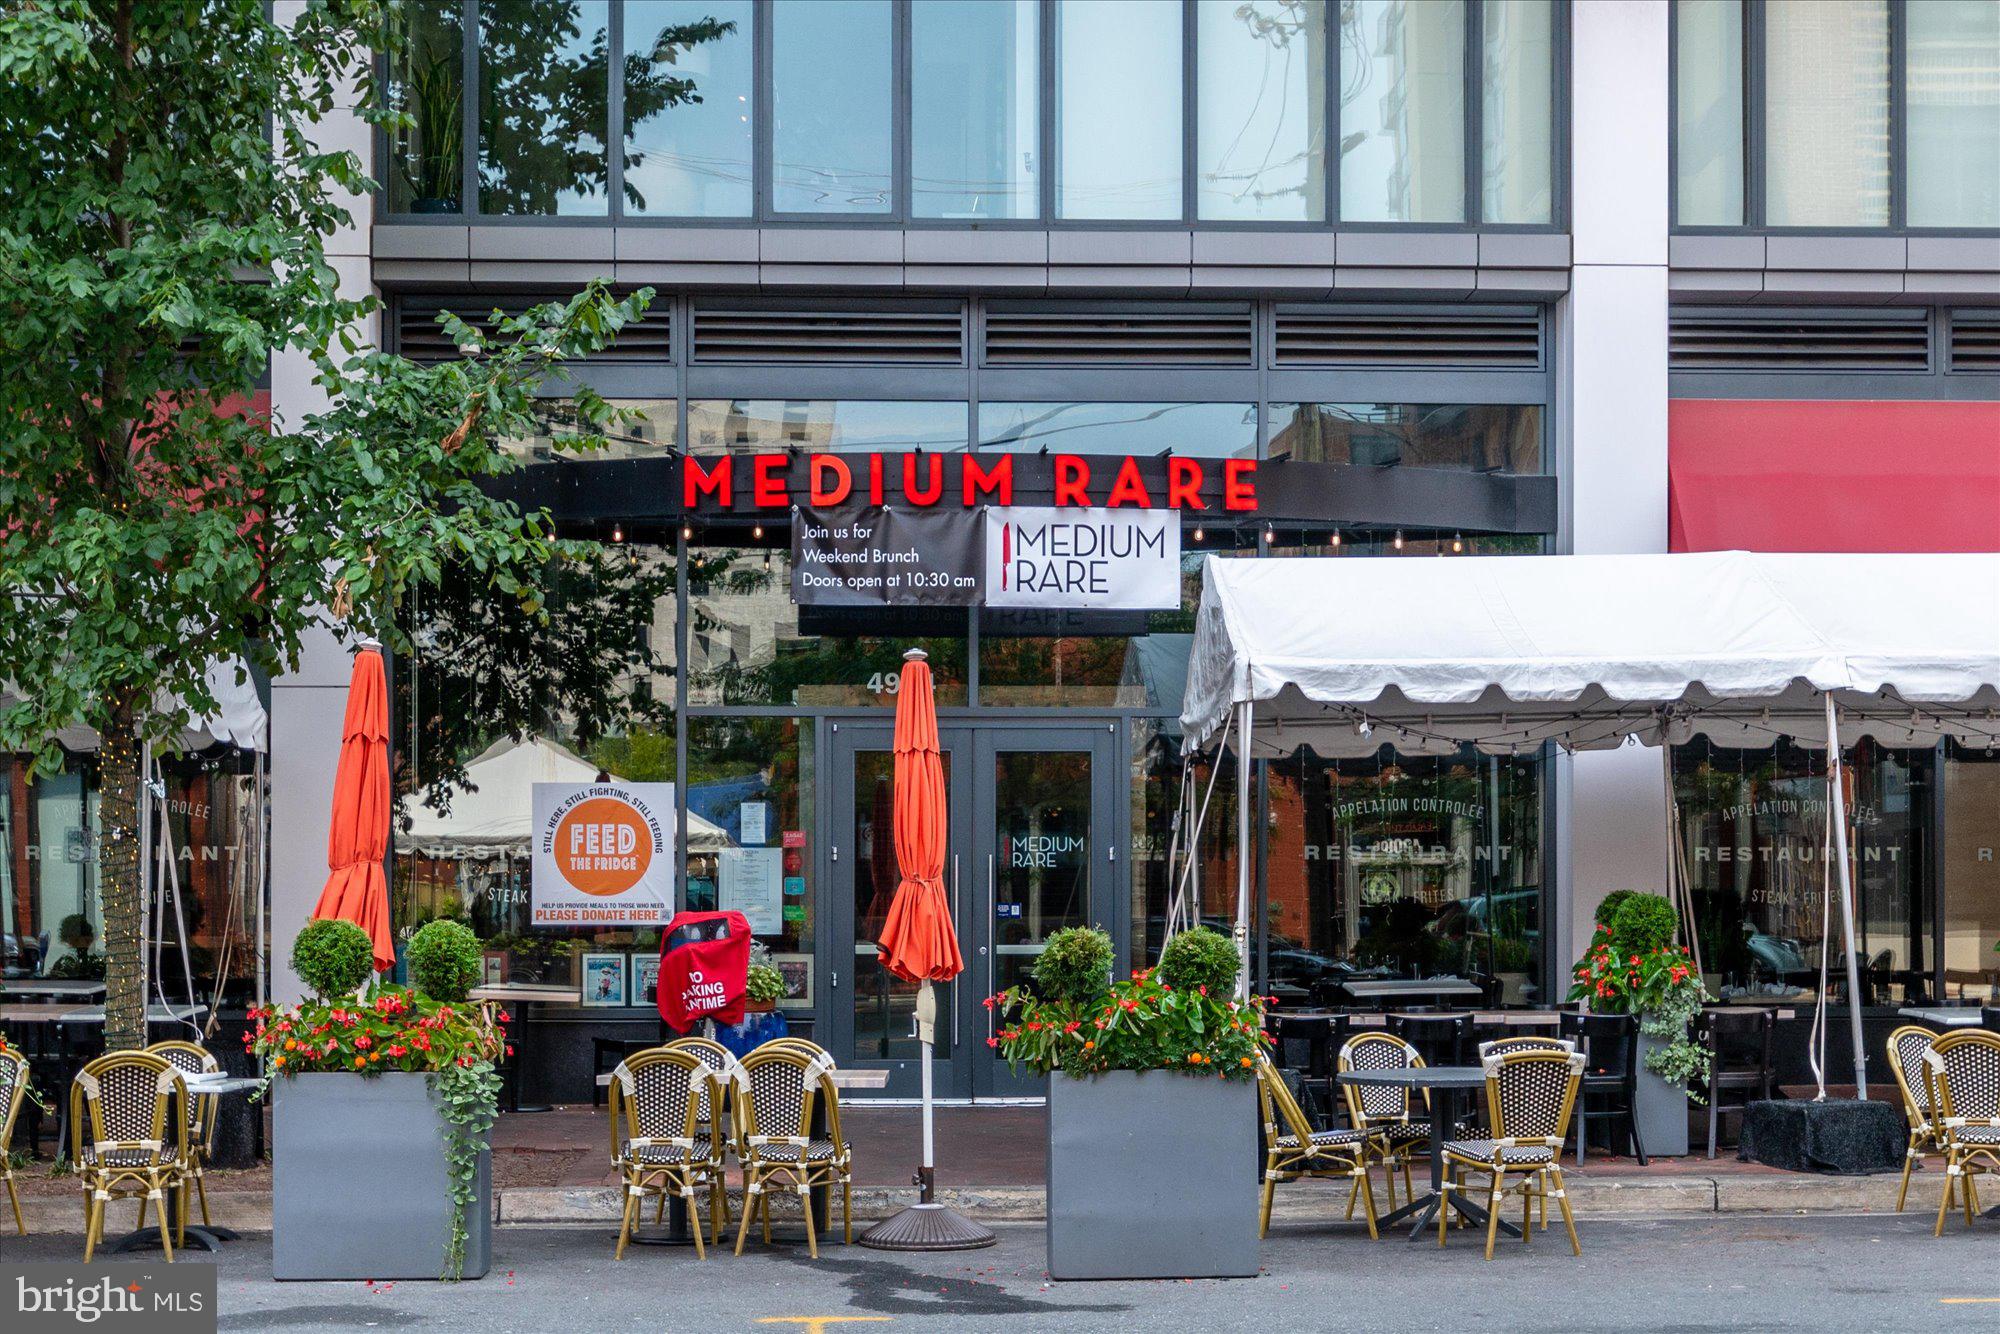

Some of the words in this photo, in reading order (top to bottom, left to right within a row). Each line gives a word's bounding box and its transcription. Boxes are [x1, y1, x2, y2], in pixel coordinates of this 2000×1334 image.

[683, 453, 1012, 507] MEDIUM
[1055, 454, 1258, 510] RARE
[802, 525, 828, 539] Join
[833, 527, 848, 539] us
[853, 523, 872, 539] for
[1016, 524, 1165, 558] MEDIUM
[803, 548, 868, 563] Weekend
[873, 548, 919, 563] Brunch
[802, 572, 843, 587] Doors
[847, 575, 882, 591] open
[886, 574, 900, 587] at
[906, 572, 949, 587] 10:30
[953, 576, 975, 587] am
[1016, 559, 1109, 594] RARE
[565, 791, 588, 807] STILL
[589, 787, 630, 803] FIGHTING,
[631, 797, 651, 818] STILL
[1332, 798, 1408, 820] APPELATION
[1722, 800, 1798, 822] APPELATION
[547, 806, 567, 828] HERE,
[543, 831, 553, 853] STILL
[570, 823, 636, 854] FEED
[648, 817, 663, 853] FEEDING
[1012, 836, 1084, 852] MEDIUM
[429, 844, 530, 859] RESTA
[1012, 852, 1057, 868] RARE
[570, 857, 591, 870] THE
[594, 857, 636, 870] FRIDGE
[487, 887, 528, 904] STEAK
[1413, 888, 1454, 904] FRITES
[535, 909, 578, 920] PLEASE
[582, 909, 625, 920] DONATE
[629, 909, 659, 920] HERE
